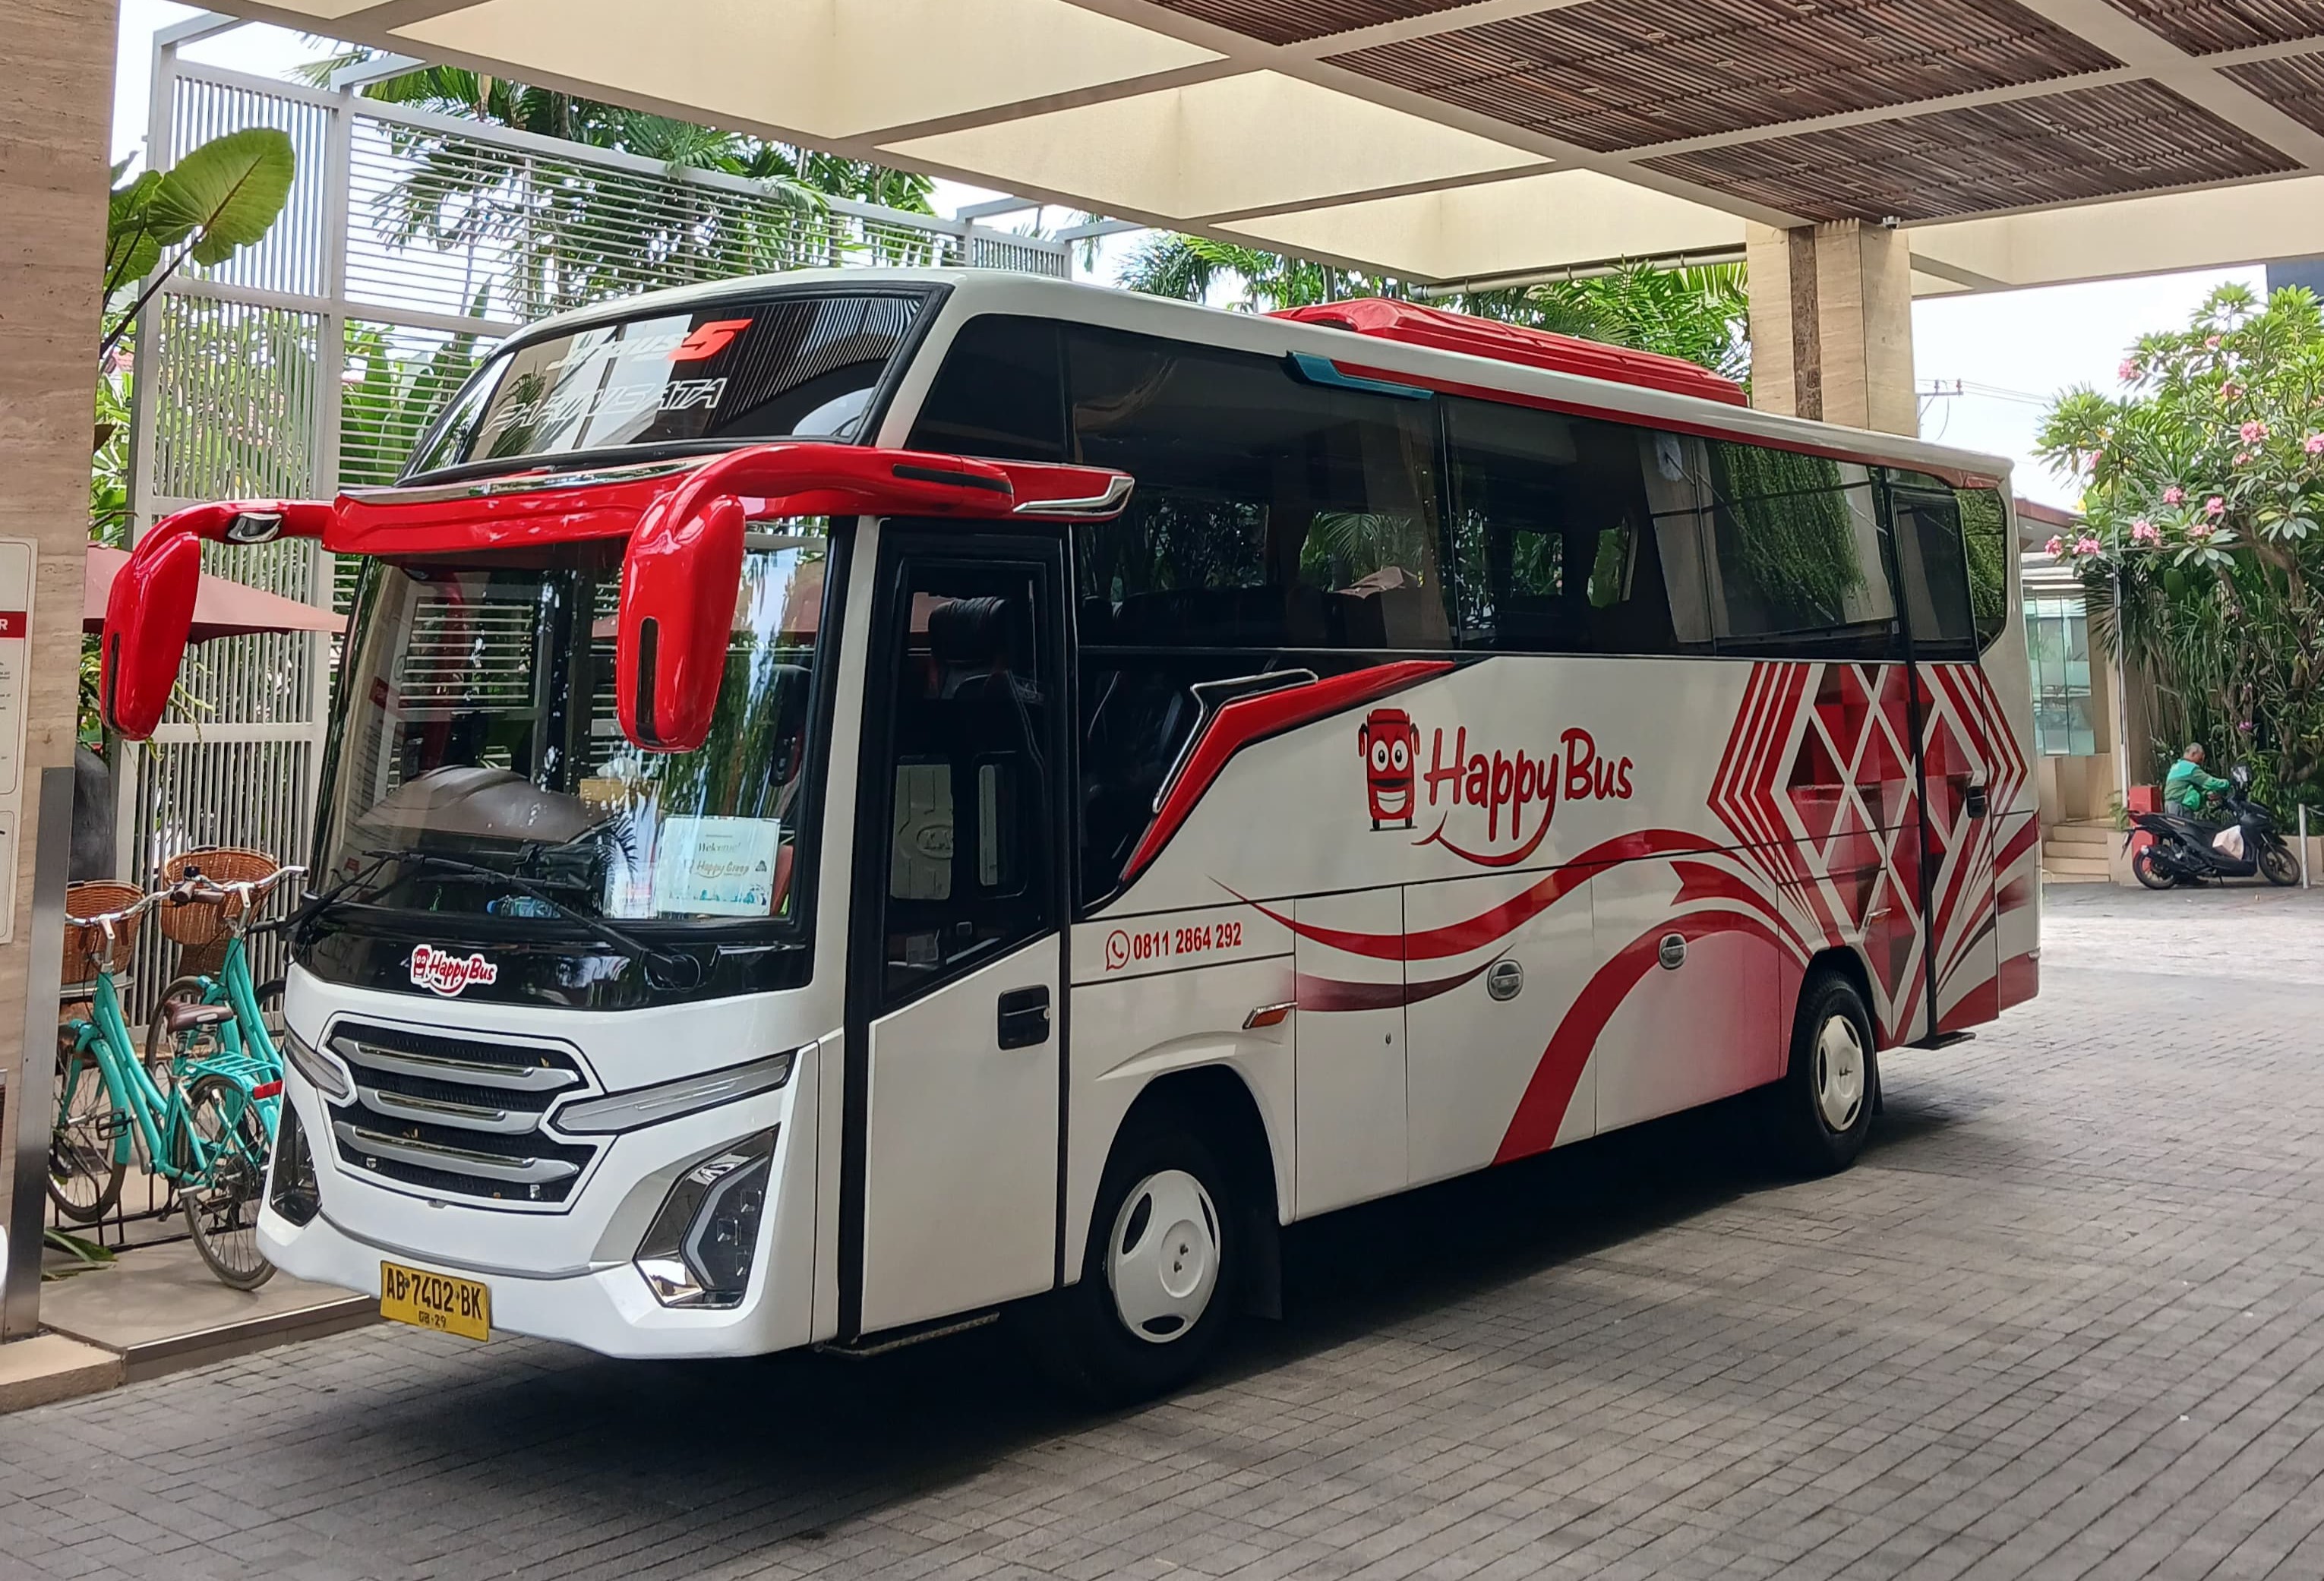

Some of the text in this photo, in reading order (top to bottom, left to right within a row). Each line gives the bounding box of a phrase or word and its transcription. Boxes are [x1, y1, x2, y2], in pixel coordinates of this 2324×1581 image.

[1133, 922, 1242, 960] 0811 2864 292
[386, 1267, 483, 1321] AB 7402 BK
